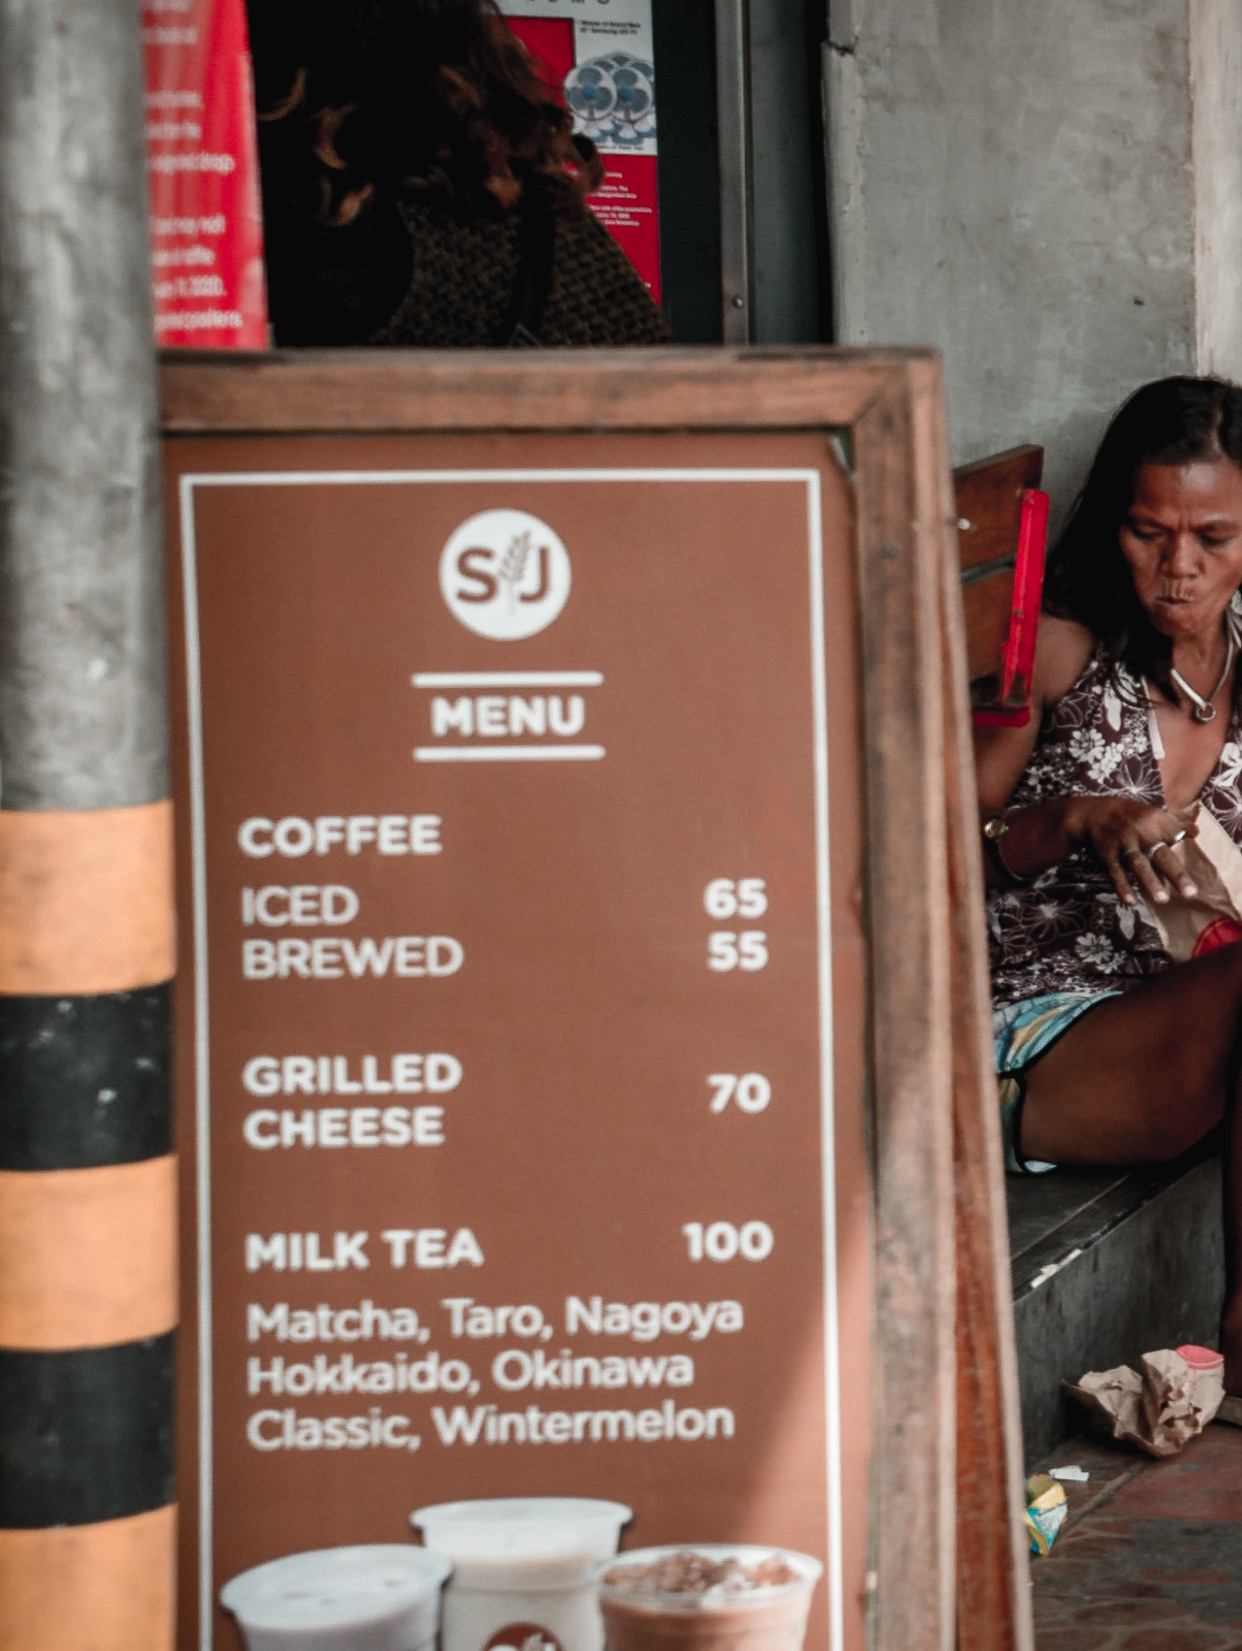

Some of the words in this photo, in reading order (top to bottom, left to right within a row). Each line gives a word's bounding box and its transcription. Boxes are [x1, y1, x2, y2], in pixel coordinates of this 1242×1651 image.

[431, 695, 586, 738] MENU
[238, 814, 443, 857] COFFEE
[242, 884, 360, 927] ICED
[703, 877, 768, 919] 65
[243, 935, 465, 979] BREWED
[708, 930, 769, 972] 55
[243, 1053, 463, 1096] GRILLED
[707, 1072, 772, 1114] 70
[243, 1105, 445, 1149] CHEESE
[246, 1231, 371, 1272] MILK
[381, 1227, 485, 1269] TEA
[683, 1220, 774, 1262] 100
[246, 1299, 431, 1345] Matcha,
[441, 1297, 554, 1341] Taro,
[564, 1295, 745, 1341] Nagoya
[247, 1351, 481, 1397] Hokkaido,
[492, 1347, 695, 1391] Okinawa
[246, 1406, 421, 1452] Classic,
[431, 1398, 735, 1446] Wintermelon
